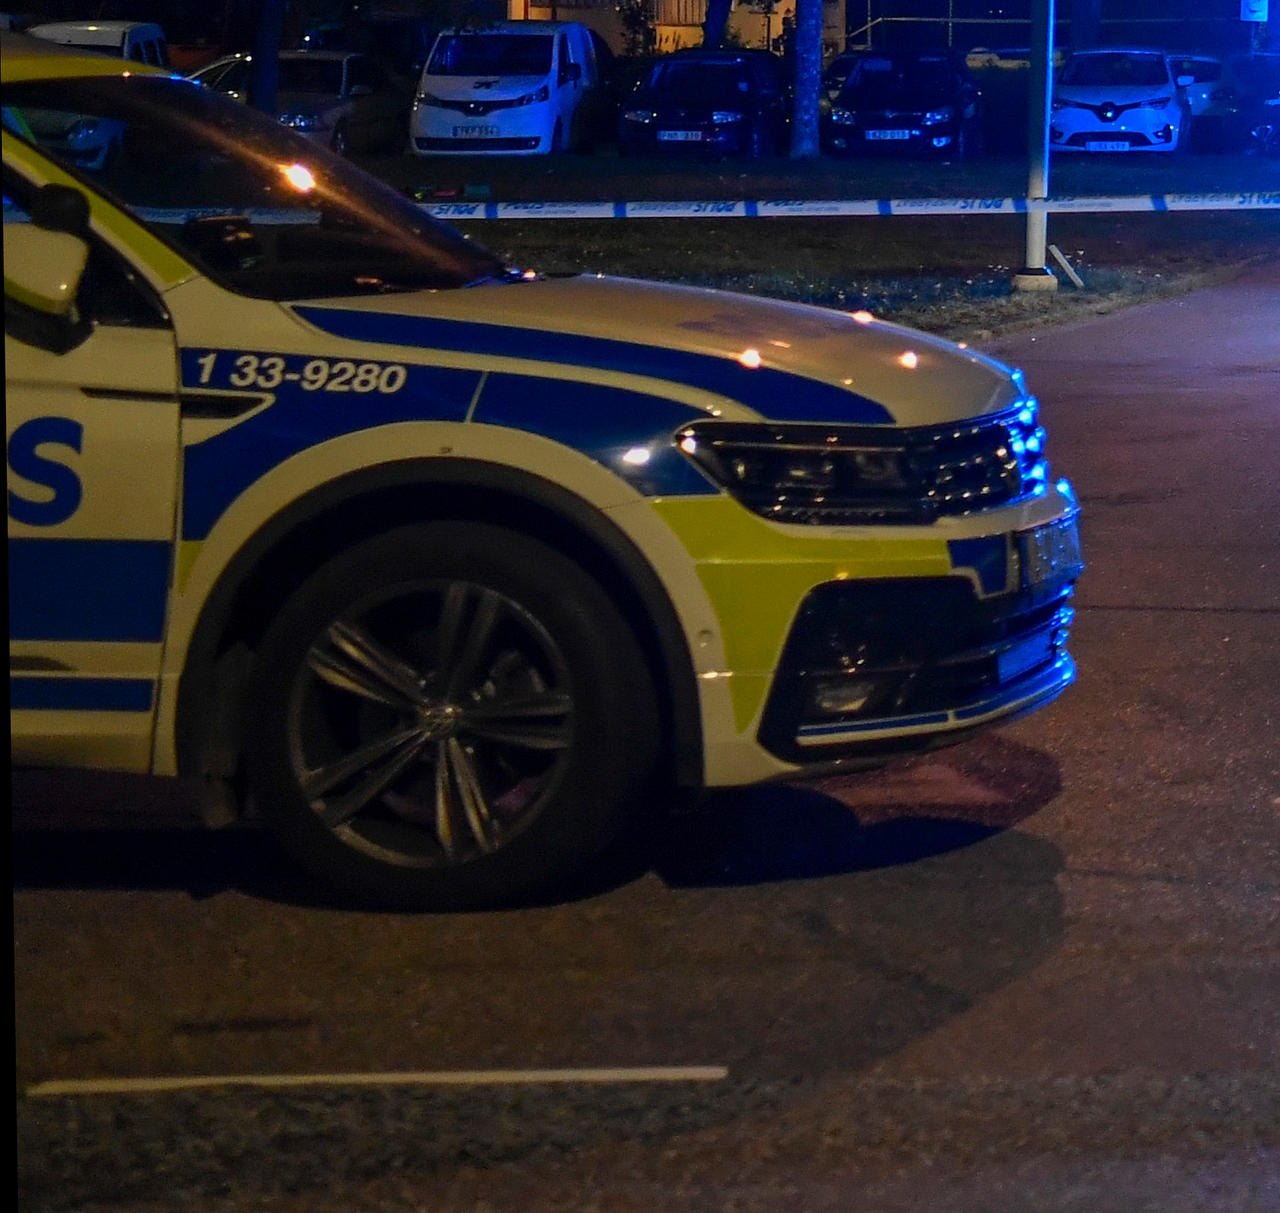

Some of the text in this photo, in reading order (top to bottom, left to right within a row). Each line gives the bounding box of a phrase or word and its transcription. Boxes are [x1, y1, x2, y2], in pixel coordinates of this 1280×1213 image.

[434, 204, 480, 216] POLIS
[196, 353, 408, 394] 1 33-9280
